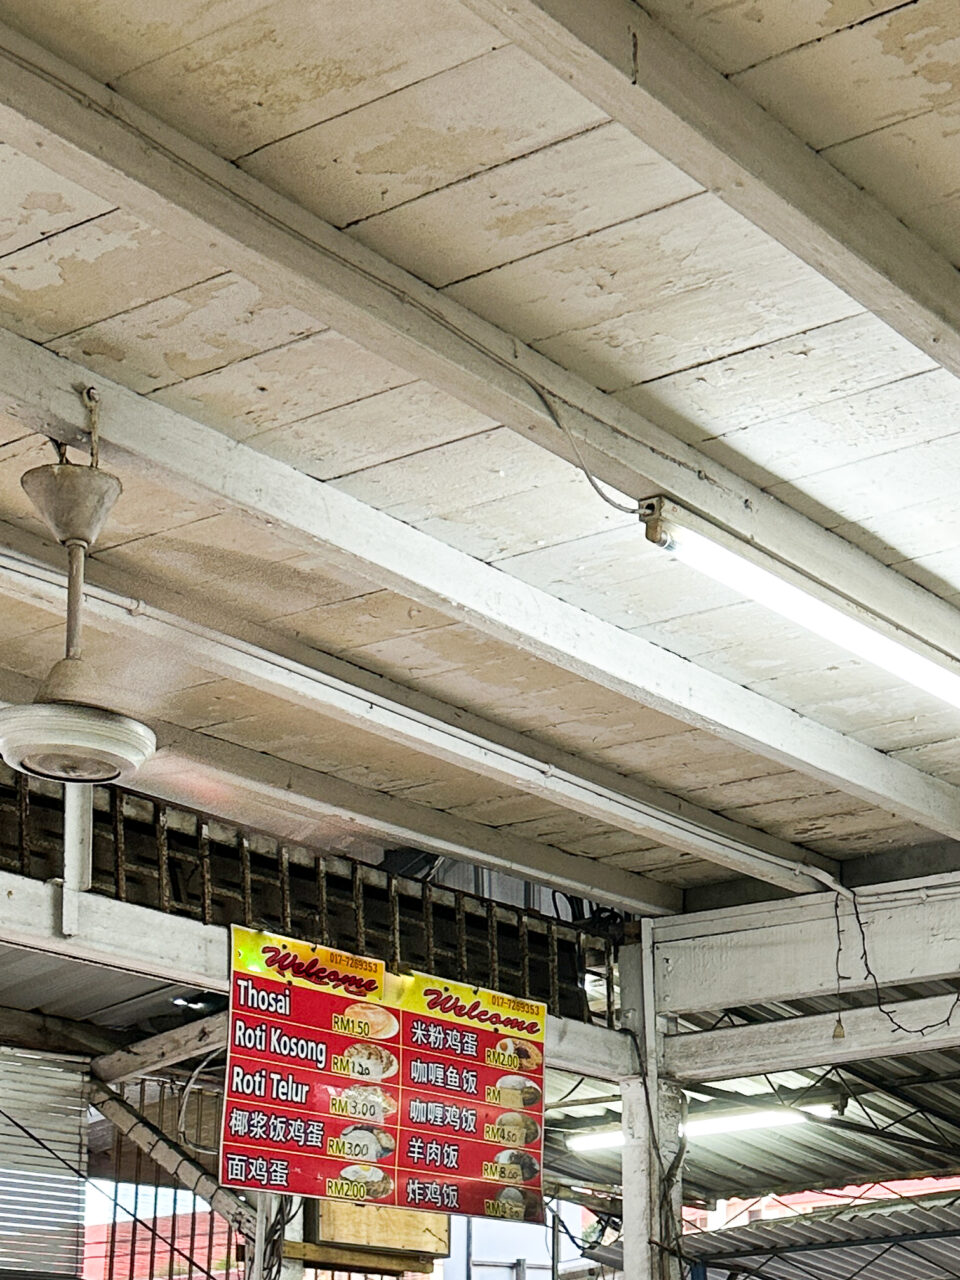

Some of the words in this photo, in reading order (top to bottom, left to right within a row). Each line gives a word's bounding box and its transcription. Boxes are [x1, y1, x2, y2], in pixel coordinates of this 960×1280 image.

[262, 946, 379, 996] Welcome
[236, 979, 291, 1015] Thosai
[423, 988, 541, 1034] Welcome
[235, 1020, 266, 1051] Roti
[270, 1027, 326, 1068] Kosong
[410, 1021, 478, 1057] 米粉鸡蛋
[232, 1066, 265, 1097] Roti
[270, 1074, 309, 1103] Telur
[410, 1059, 478, 1095] 咖喱鱼饭
[229, 1108, 324, 1148] 椰浆饭鸡蛋
[409, 1098, 477, 1133] 咖喱鸡饭
[227, 1154, 289, 1187] 面鸡蛋
[407, 1137, 459, 1169] 羊肉饭
[406, 1179, 459, 1209] 炸鸡饭
